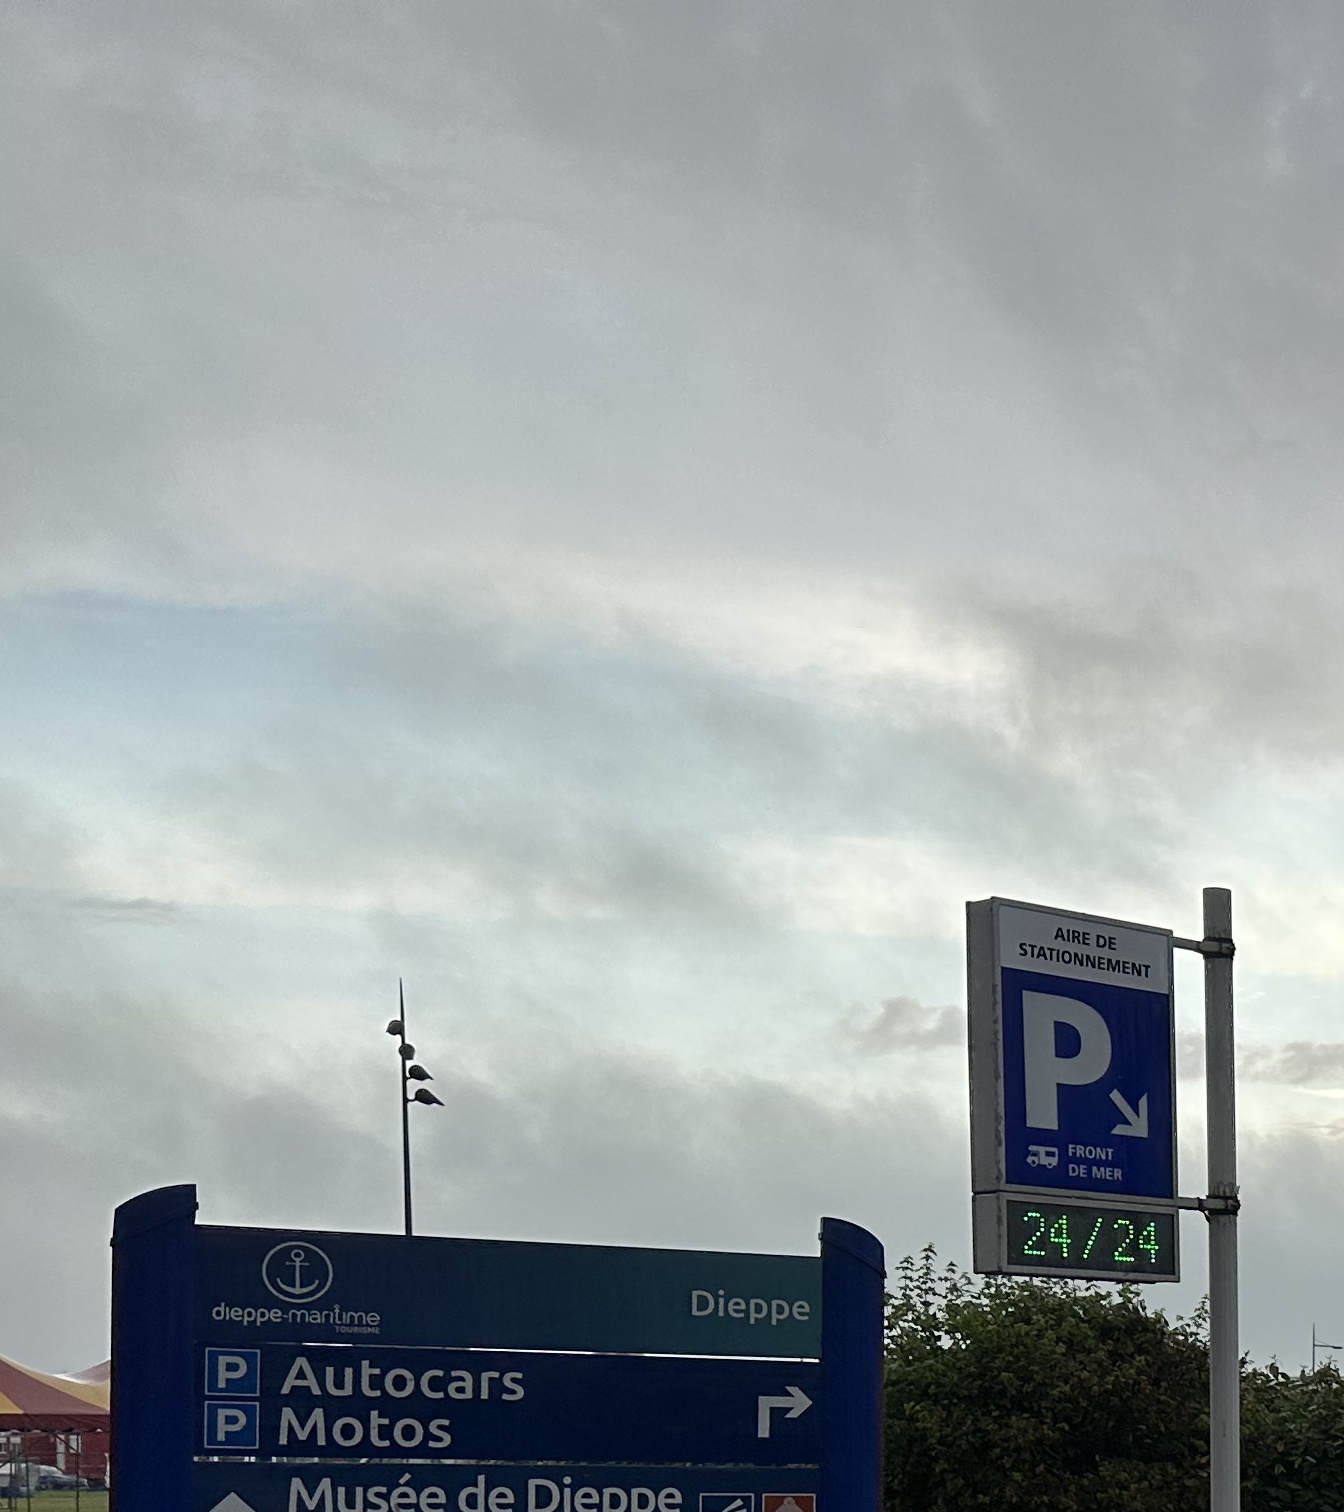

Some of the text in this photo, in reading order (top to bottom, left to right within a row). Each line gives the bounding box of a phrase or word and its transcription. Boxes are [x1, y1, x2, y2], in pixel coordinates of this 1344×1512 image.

[1054, 926, 1117, 951] AIRE DE
[1018, 943, 1151, 979] STATIONNEMENT
[1022, 989, 1112, 1130] P
[1068, 1144, 1114, 1161] FRONT
[1068, 1164, 1123, 1181] DE MER
[212, 1302, 381, 1326] dieppe-maritime
[691, 1289, 811, 1326] Dieppe
[334, 1325, 381, 1335] TOURISME
[280, 1356, 525, 1401] Autocars
[278, 1406, 453, 1449] Motos
